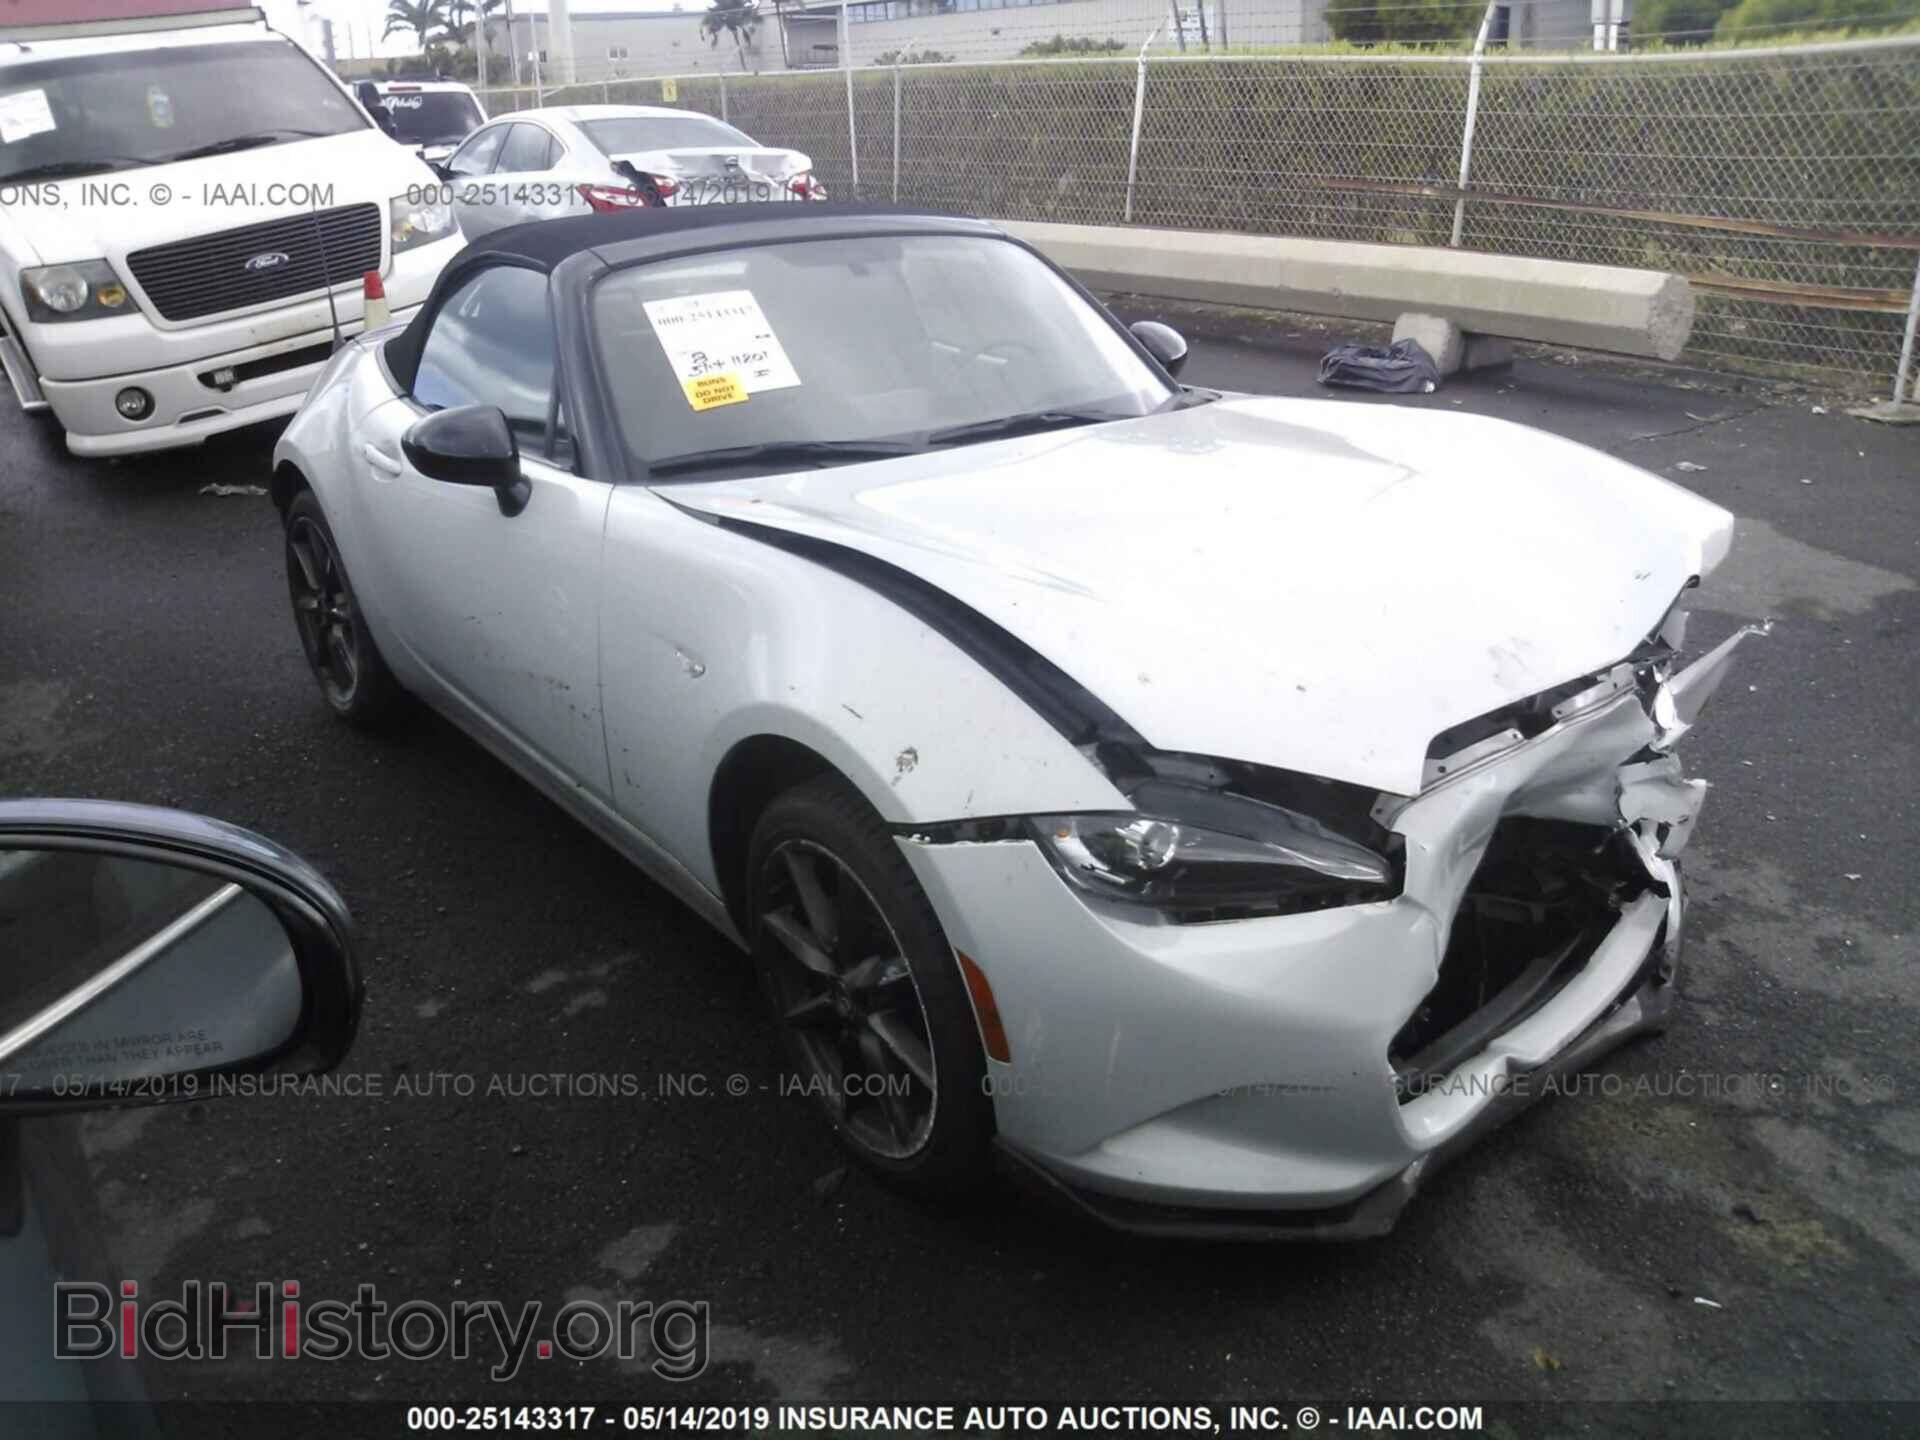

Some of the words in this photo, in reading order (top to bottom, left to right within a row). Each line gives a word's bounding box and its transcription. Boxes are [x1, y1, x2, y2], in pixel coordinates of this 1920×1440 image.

[696, 389, 712, 399] DO
[714, 385, 735, 394] NOT
[703, 392, 733, 404] DRIVE
